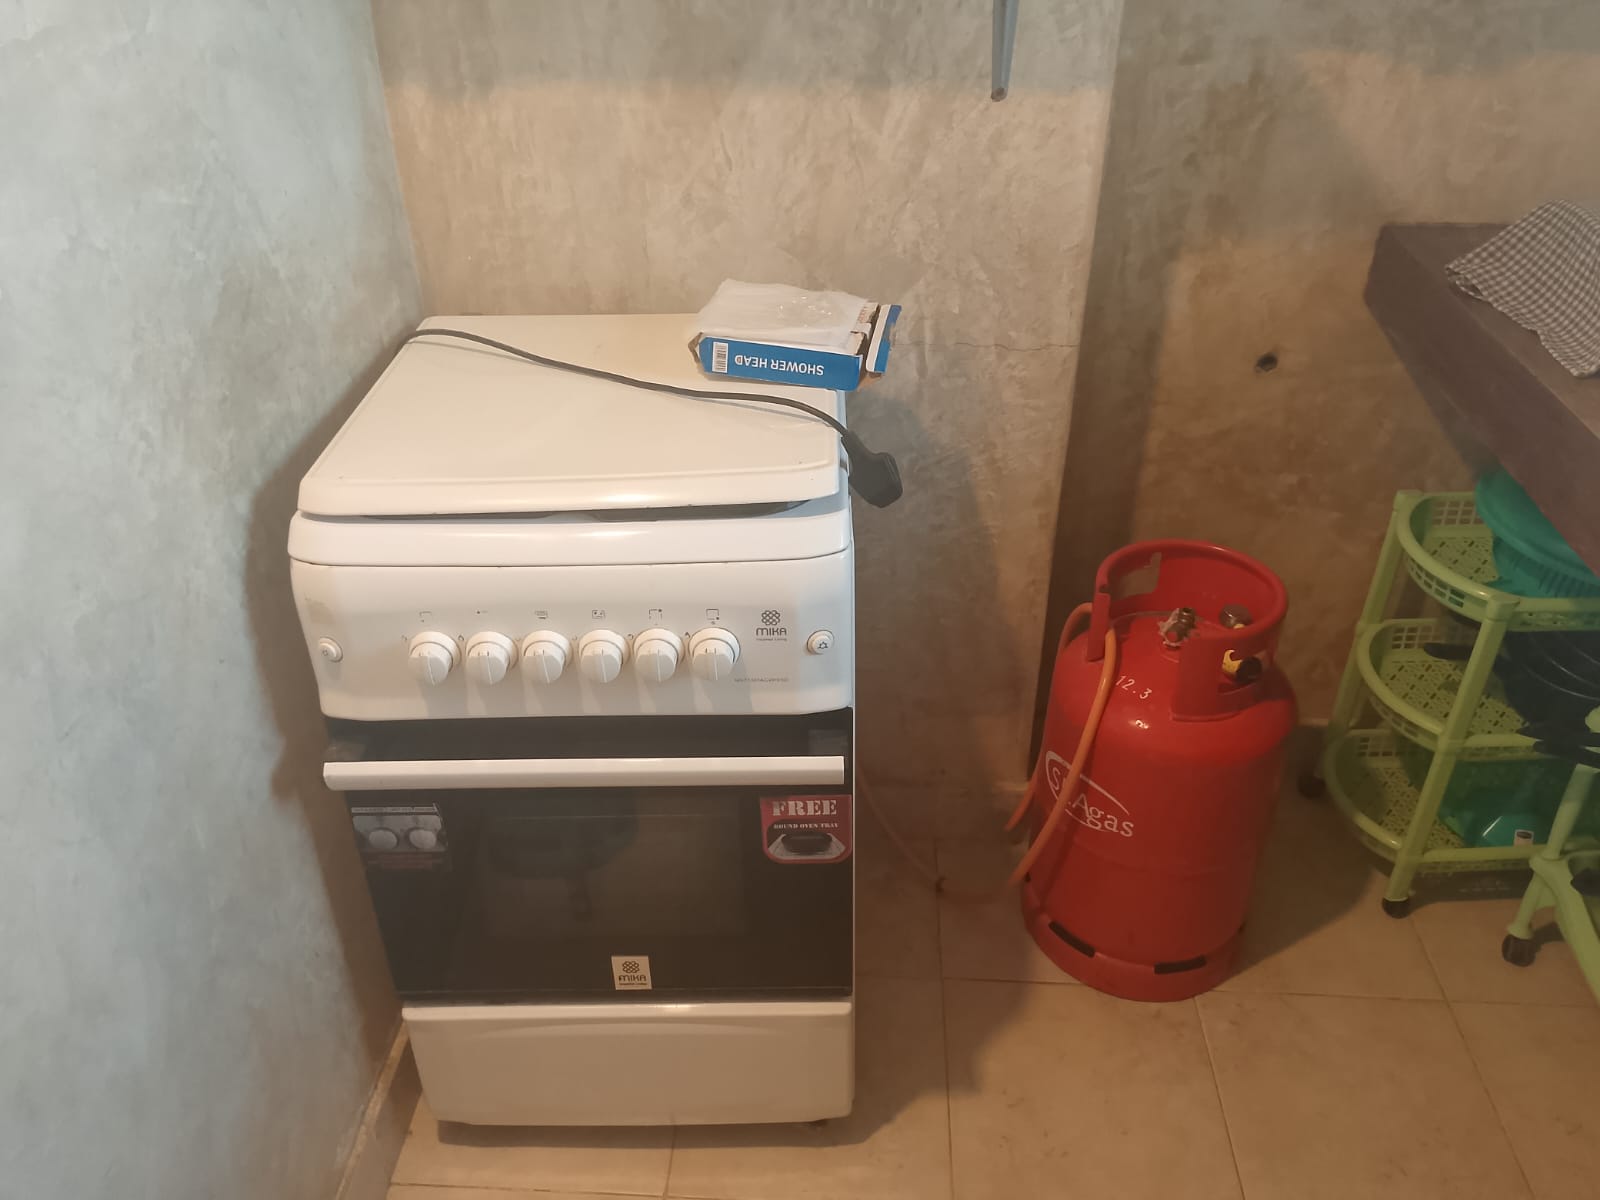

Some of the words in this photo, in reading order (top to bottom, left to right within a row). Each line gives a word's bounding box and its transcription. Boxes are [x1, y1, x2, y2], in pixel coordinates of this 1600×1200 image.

[734, 354, 768, 369] HEAD
[770, 356, 825, 376] SHOWER
[1115, 675, 1153, 700] 12.3
[772, 799, 837, 817] FREE
